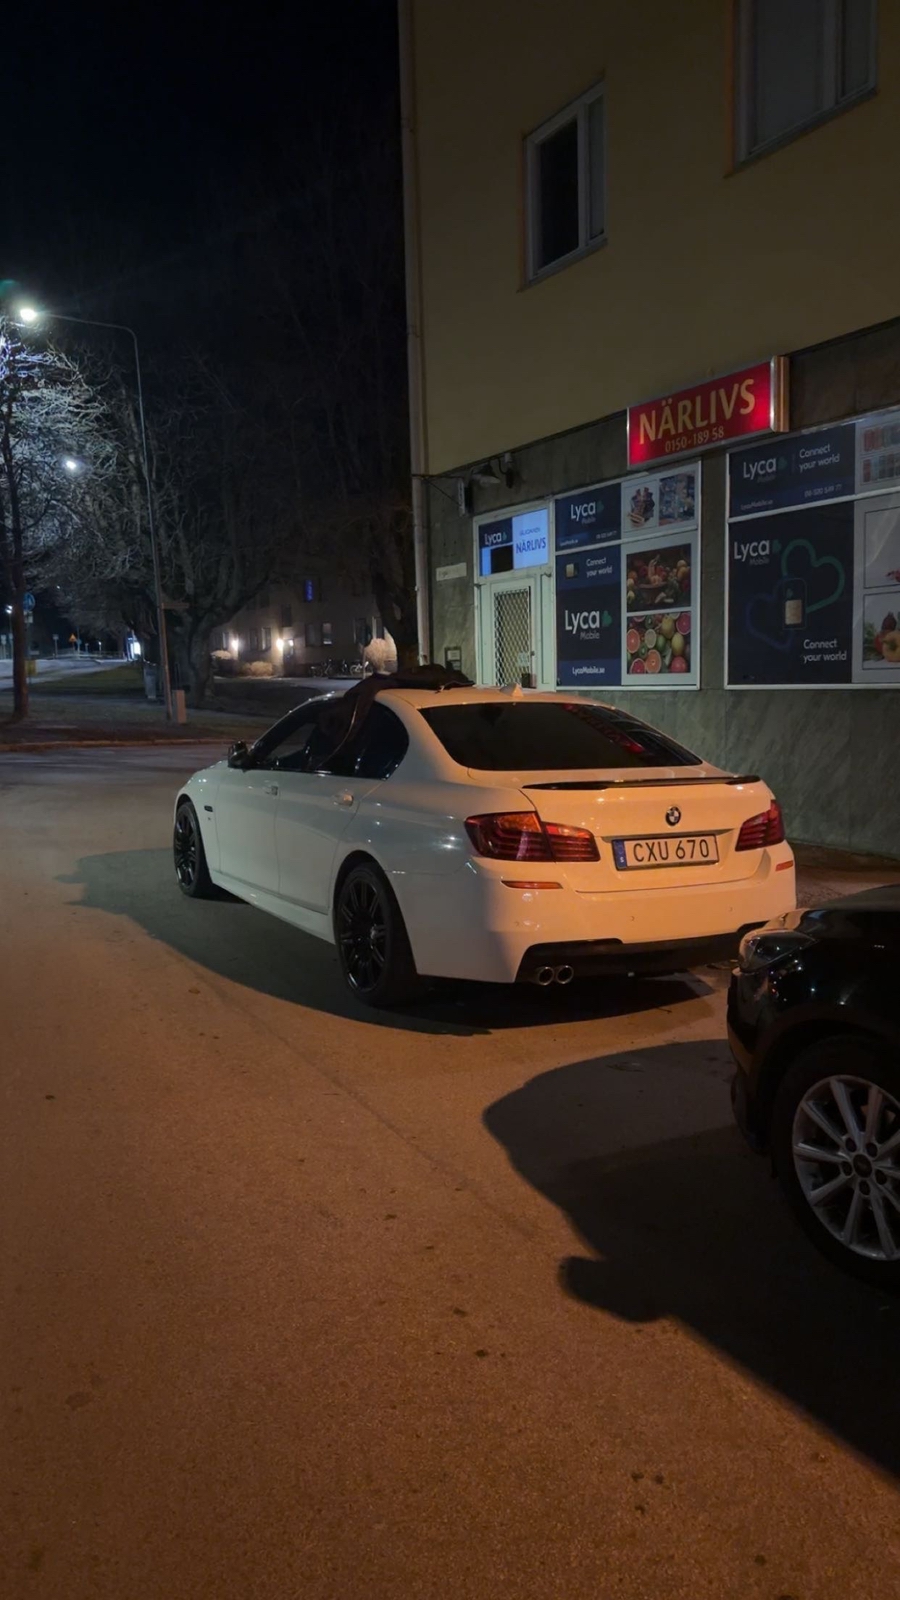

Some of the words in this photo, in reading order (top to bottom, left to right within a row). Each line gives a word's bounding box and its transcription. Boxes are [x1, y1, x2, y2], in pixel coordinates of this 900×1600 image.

[640, 379, 755, 445] NÄRLIVS
[665, 430, 709, 453] 0150-189
[712, 426, 724, 439] 58
[800, 443, 831, 459] Connect
[743, 458, 777, 480] Lyca
[799, 461, 816, 473] your
[818, 453, 840, 467] world
[570, 501, 596, 522] Lyca
[484, 532, 502, 546] Lyca
[515, 537, 547, 554] NÄRLIVS
[733, 539, 770, 562] Lyca
[586, 557, 607, 567] Connect
[586, 569, 597, 578] your
[598, 566, 613, 575] world
[564, 609, 600, 635] Lyca
[580, 630, 600, 640] Mobile
[803, 638, 838, 650] Connect
[803, 653, 821, 664] your
[823, 650, 847, 661] world
[633, 841, 669, 862] CXU
[675, 839, 709, 859] 670
